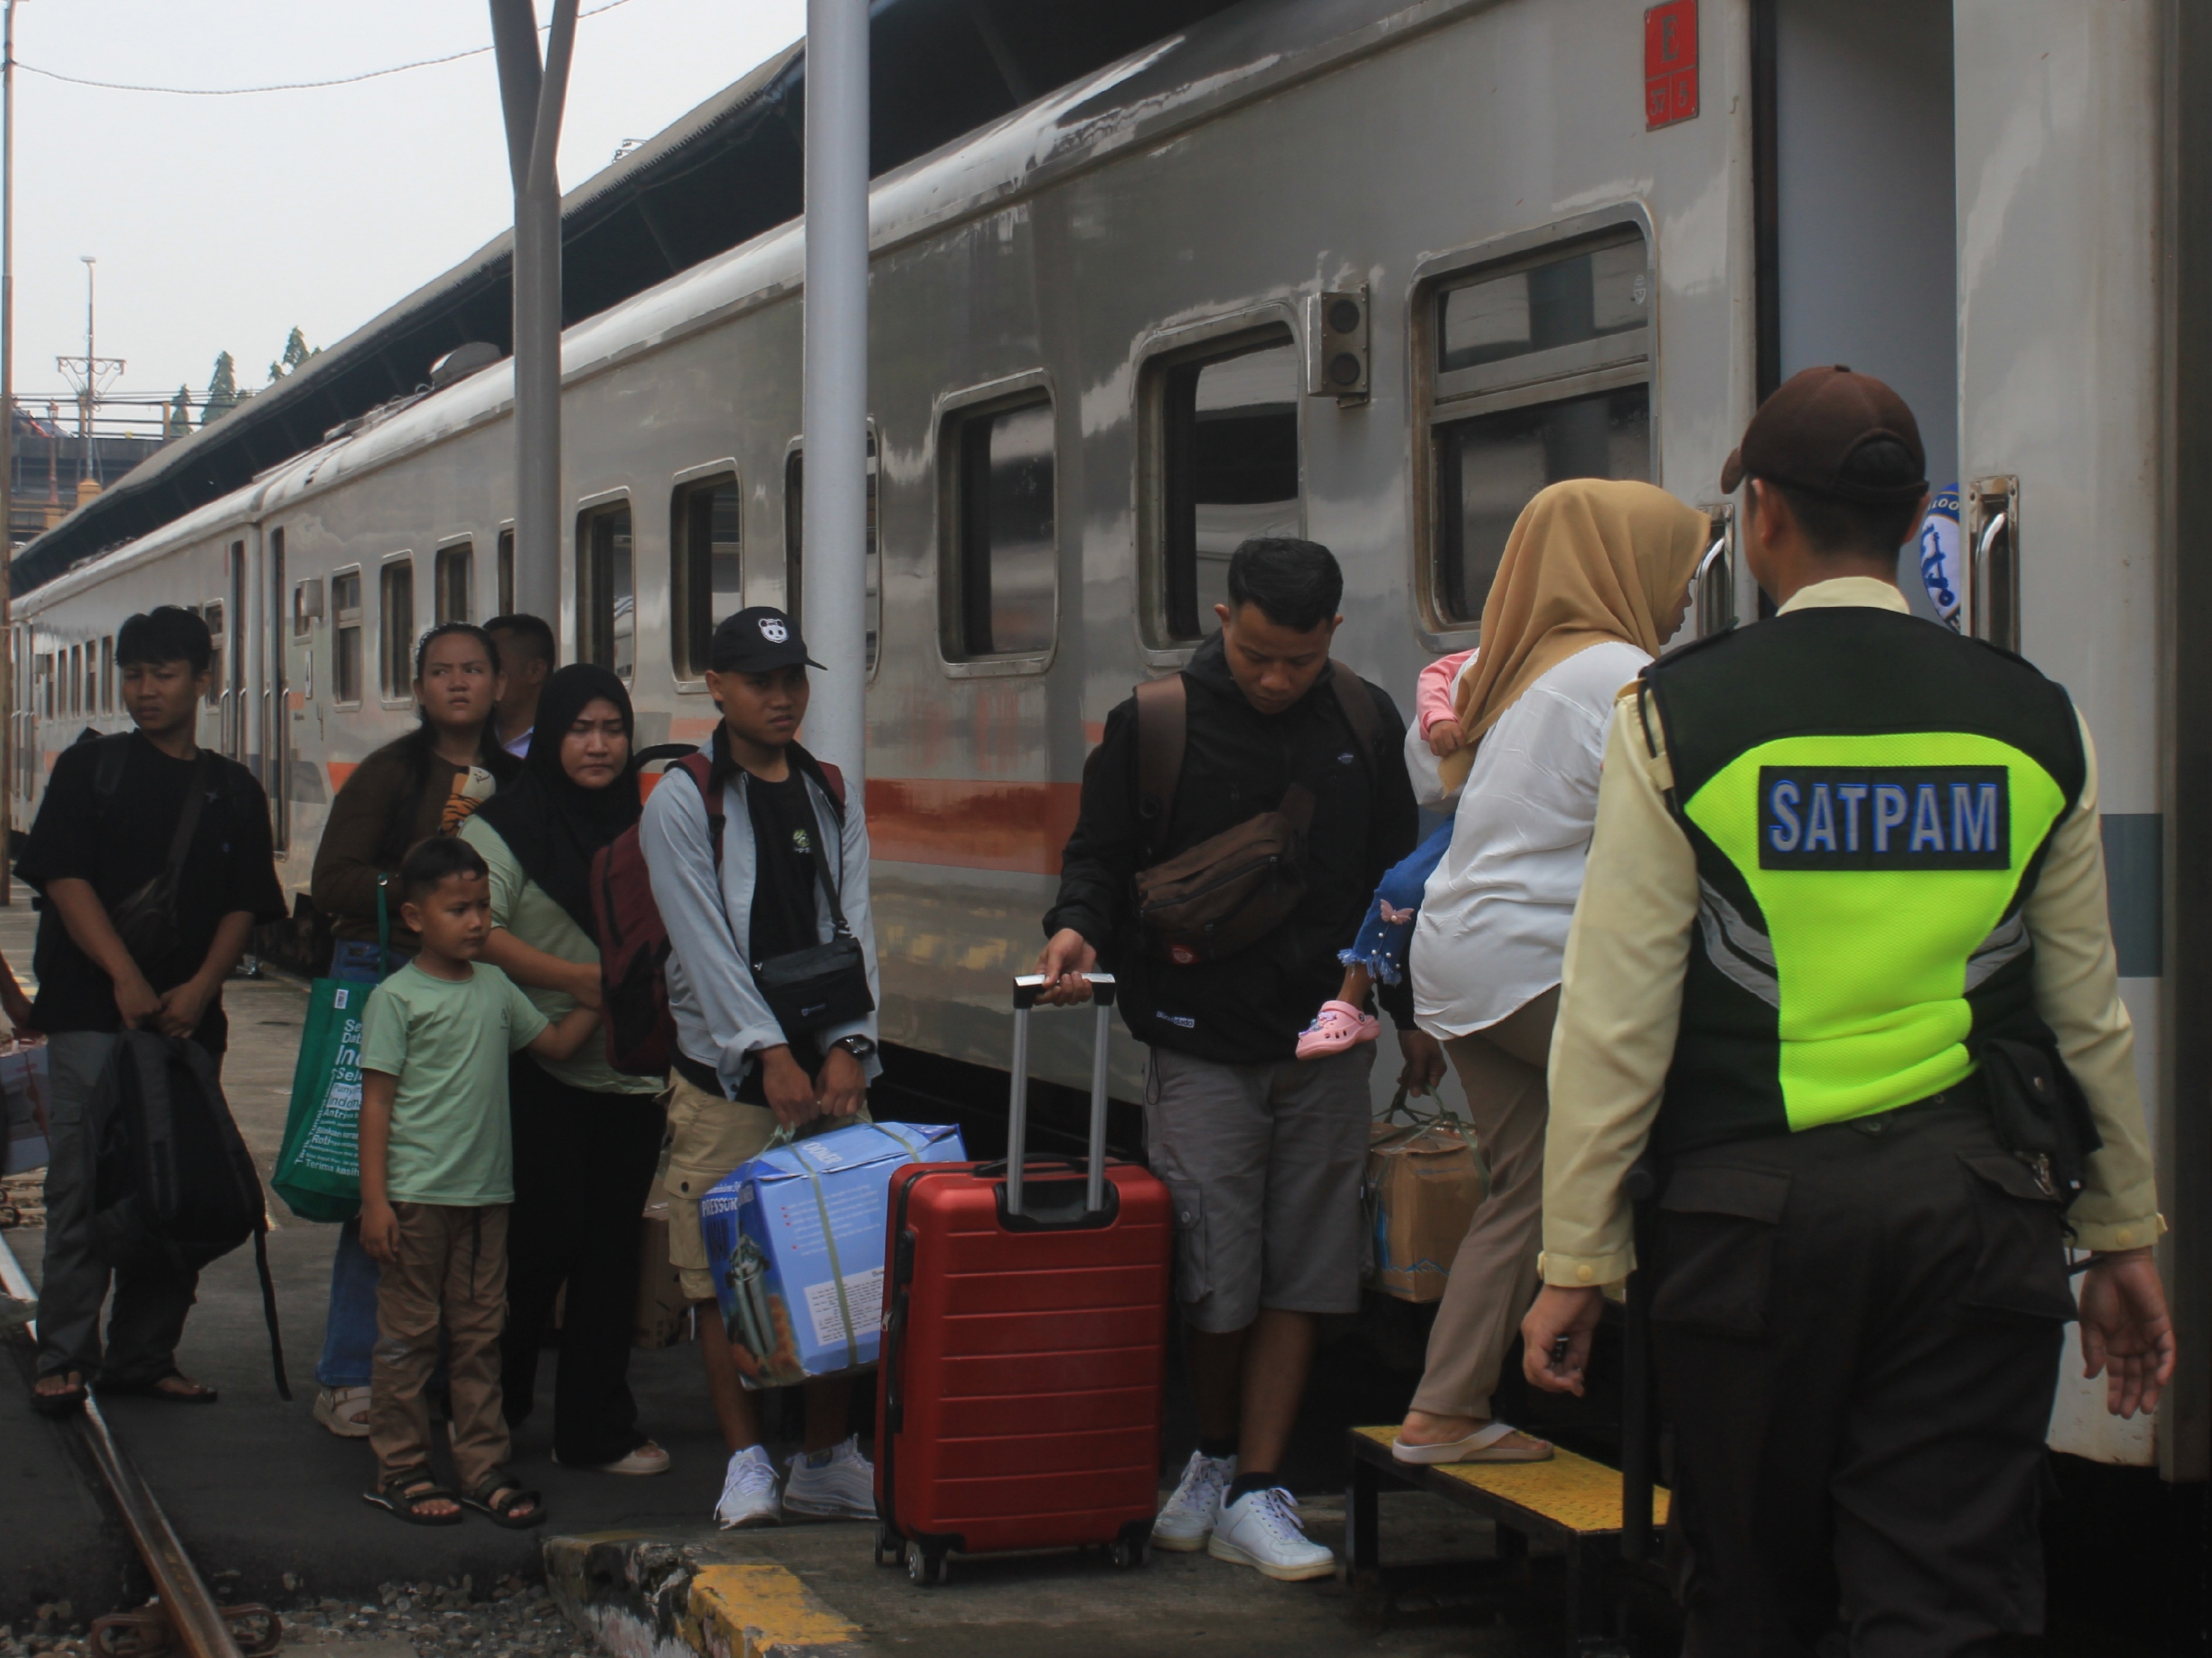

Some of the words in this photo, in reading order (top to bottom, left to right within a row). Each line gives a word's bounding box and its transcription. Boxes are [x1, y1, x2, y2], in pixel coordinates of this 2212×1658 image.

[1661, 13, 1680, 63] E
[1769, 780, 1998, 852] SATPAM
[344, 1019, 362, 1032] Se
[341, 1032, 362, 1044] Dat
[305, 1159, 334, 1172] Terima
[336, 1164, 359, 1177] kasih
